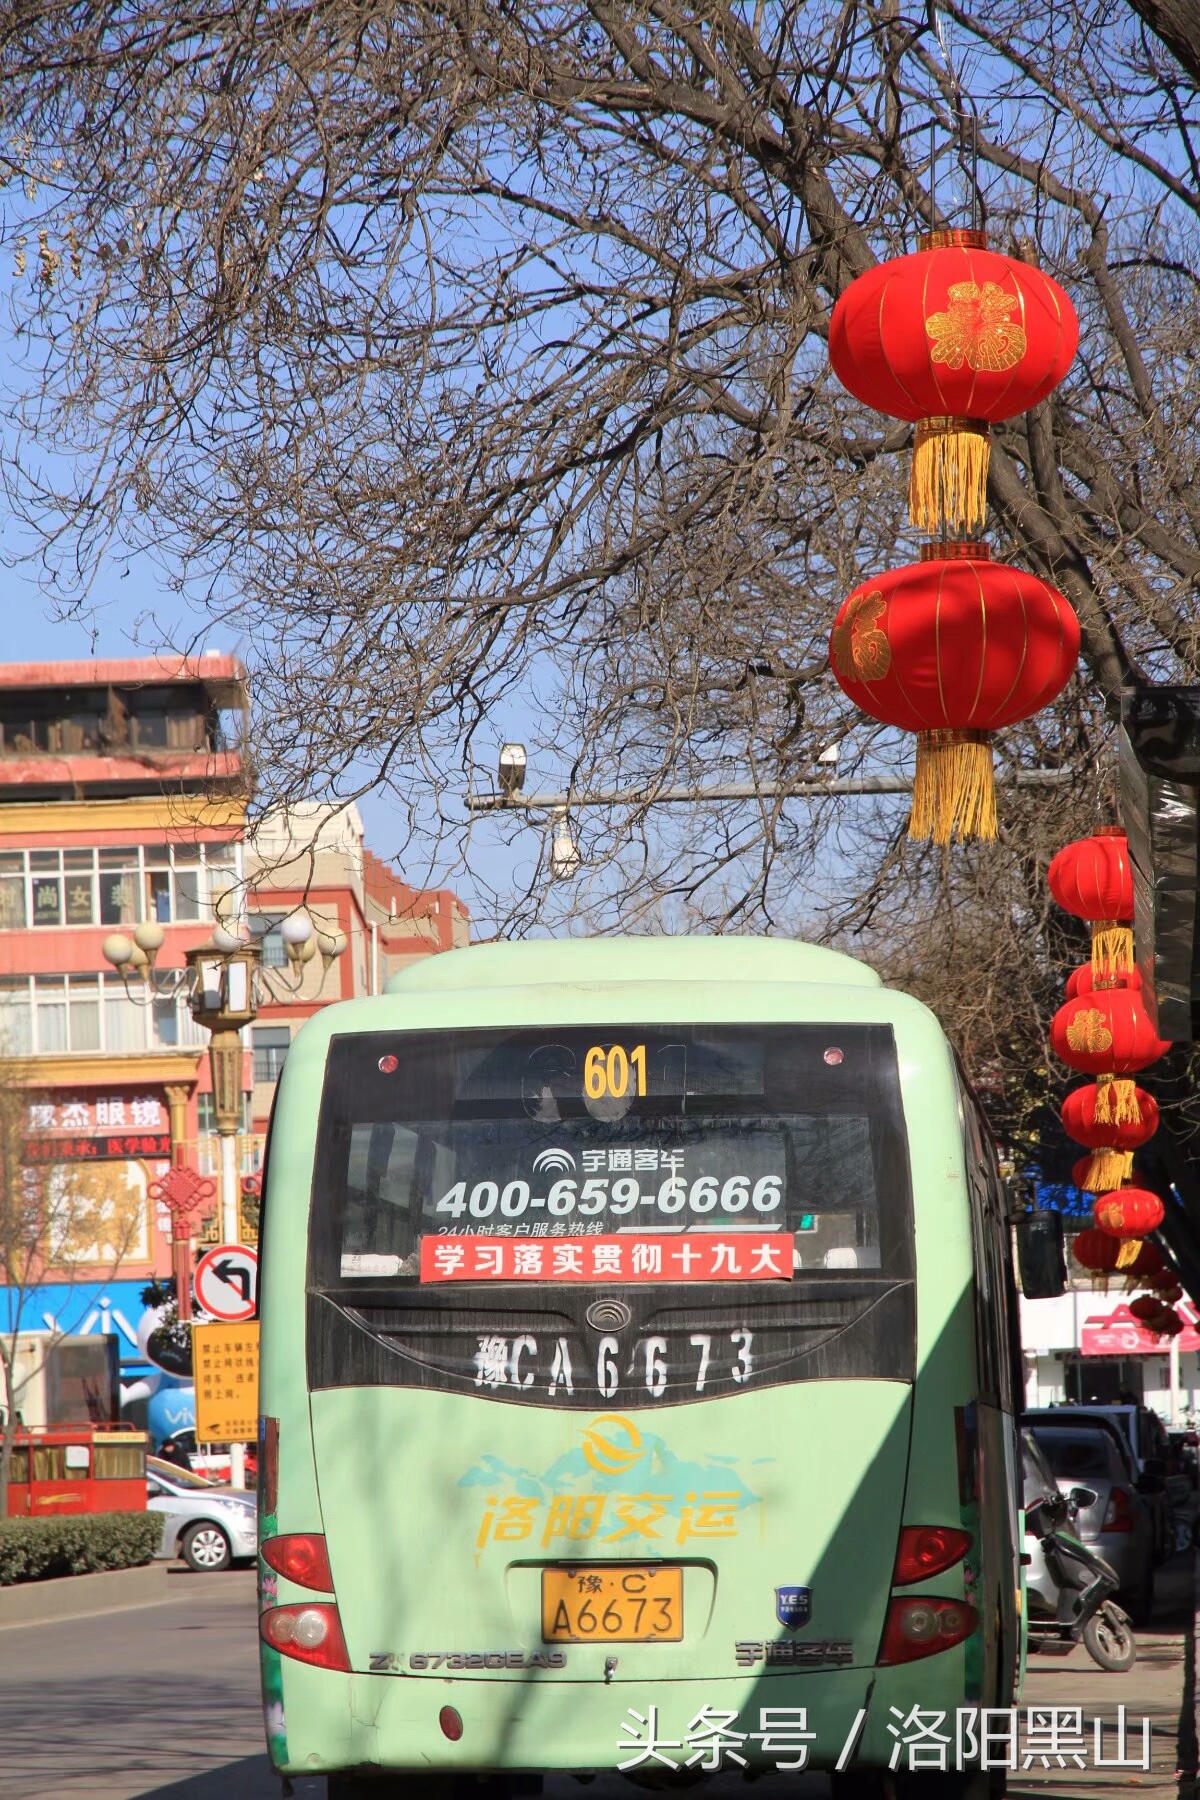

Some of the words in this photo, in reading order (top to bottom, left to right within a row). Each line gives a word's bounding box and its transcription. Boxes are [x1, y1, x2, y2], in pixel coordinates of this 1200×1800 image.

[584, 1045, 647, 1099] 601
[581, 1148, 685, 1172] 宇通客车
[436, 1175, 783, 1218] 400-659-6666
[438, 1221, 604, 1237] 24小时客户服务热线
[434, 1243, 783, 1275] 学习落实贯彻十九大
[475, 1491, 742, 1549] 洛阳交运
[552, 1597, 673, 1635] A6673
